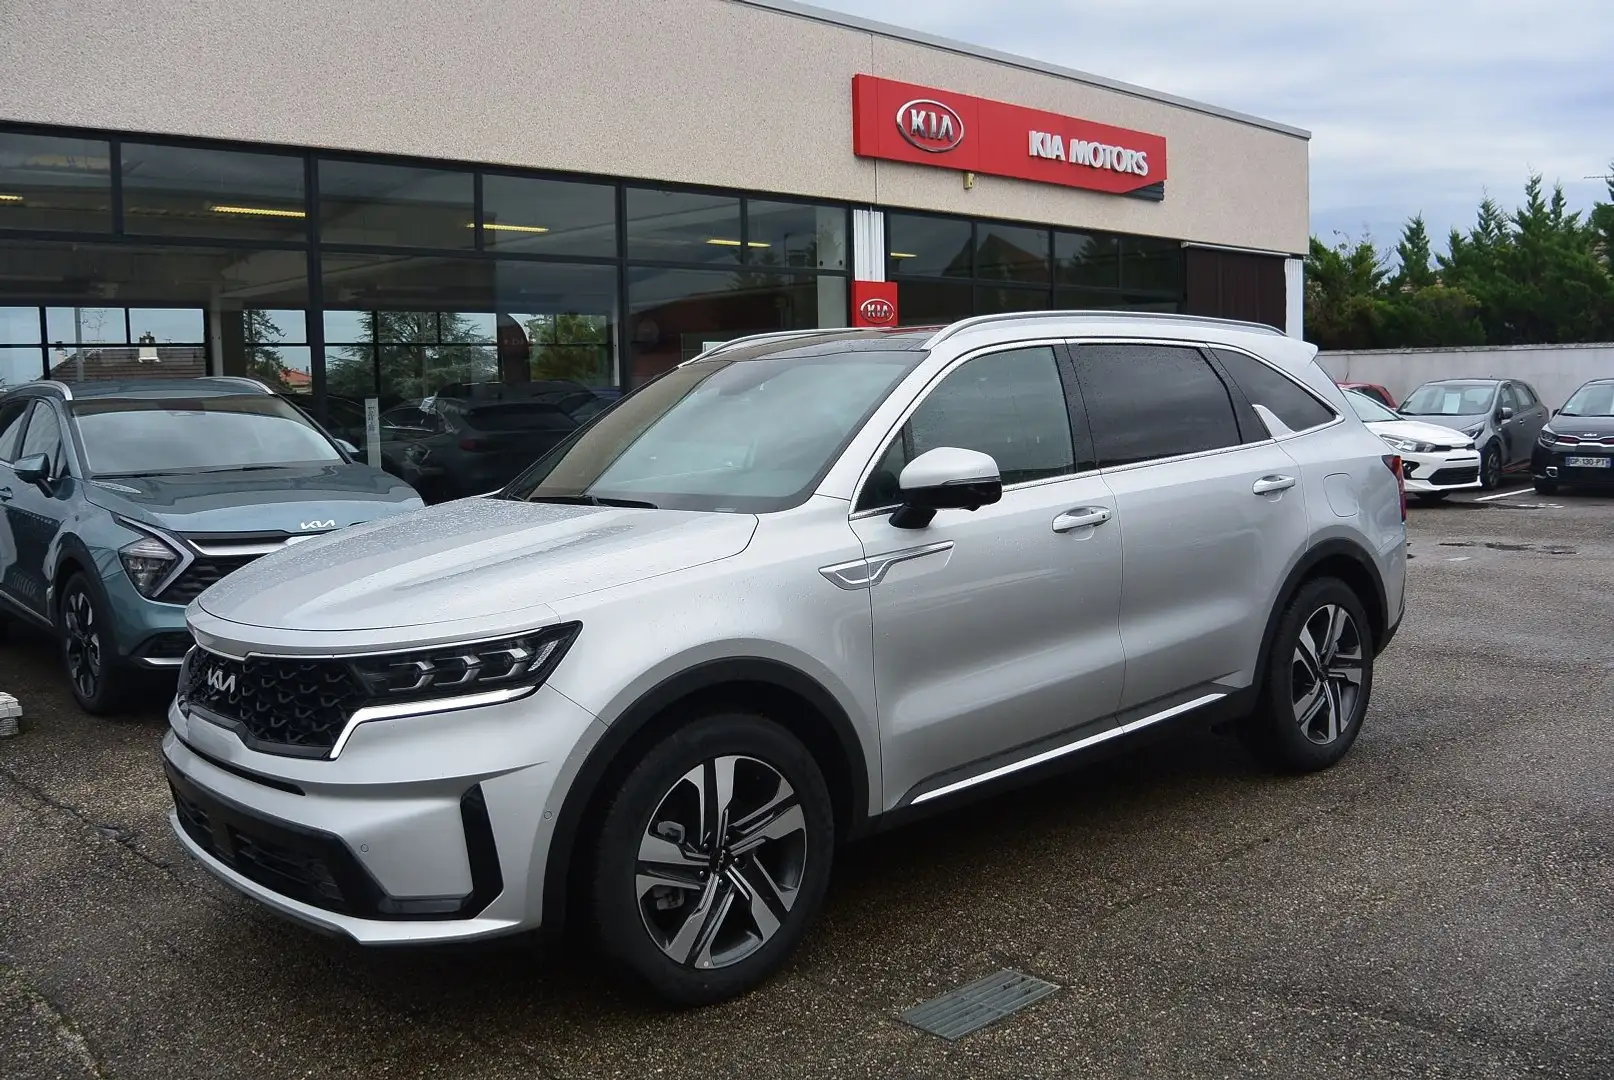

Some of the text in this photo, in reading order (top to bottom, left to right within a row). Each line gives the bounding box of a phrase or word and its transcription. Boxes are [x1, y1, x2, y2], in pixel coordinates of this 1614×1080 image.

[910, 108, 954, 142] KIA
[1028, 130, 1149, 177] KIA MOTORS
[867, 304, 889, 318] KIA
[300, 519, 336, 530] KIA
[207, 667, 236, 694] KIA
